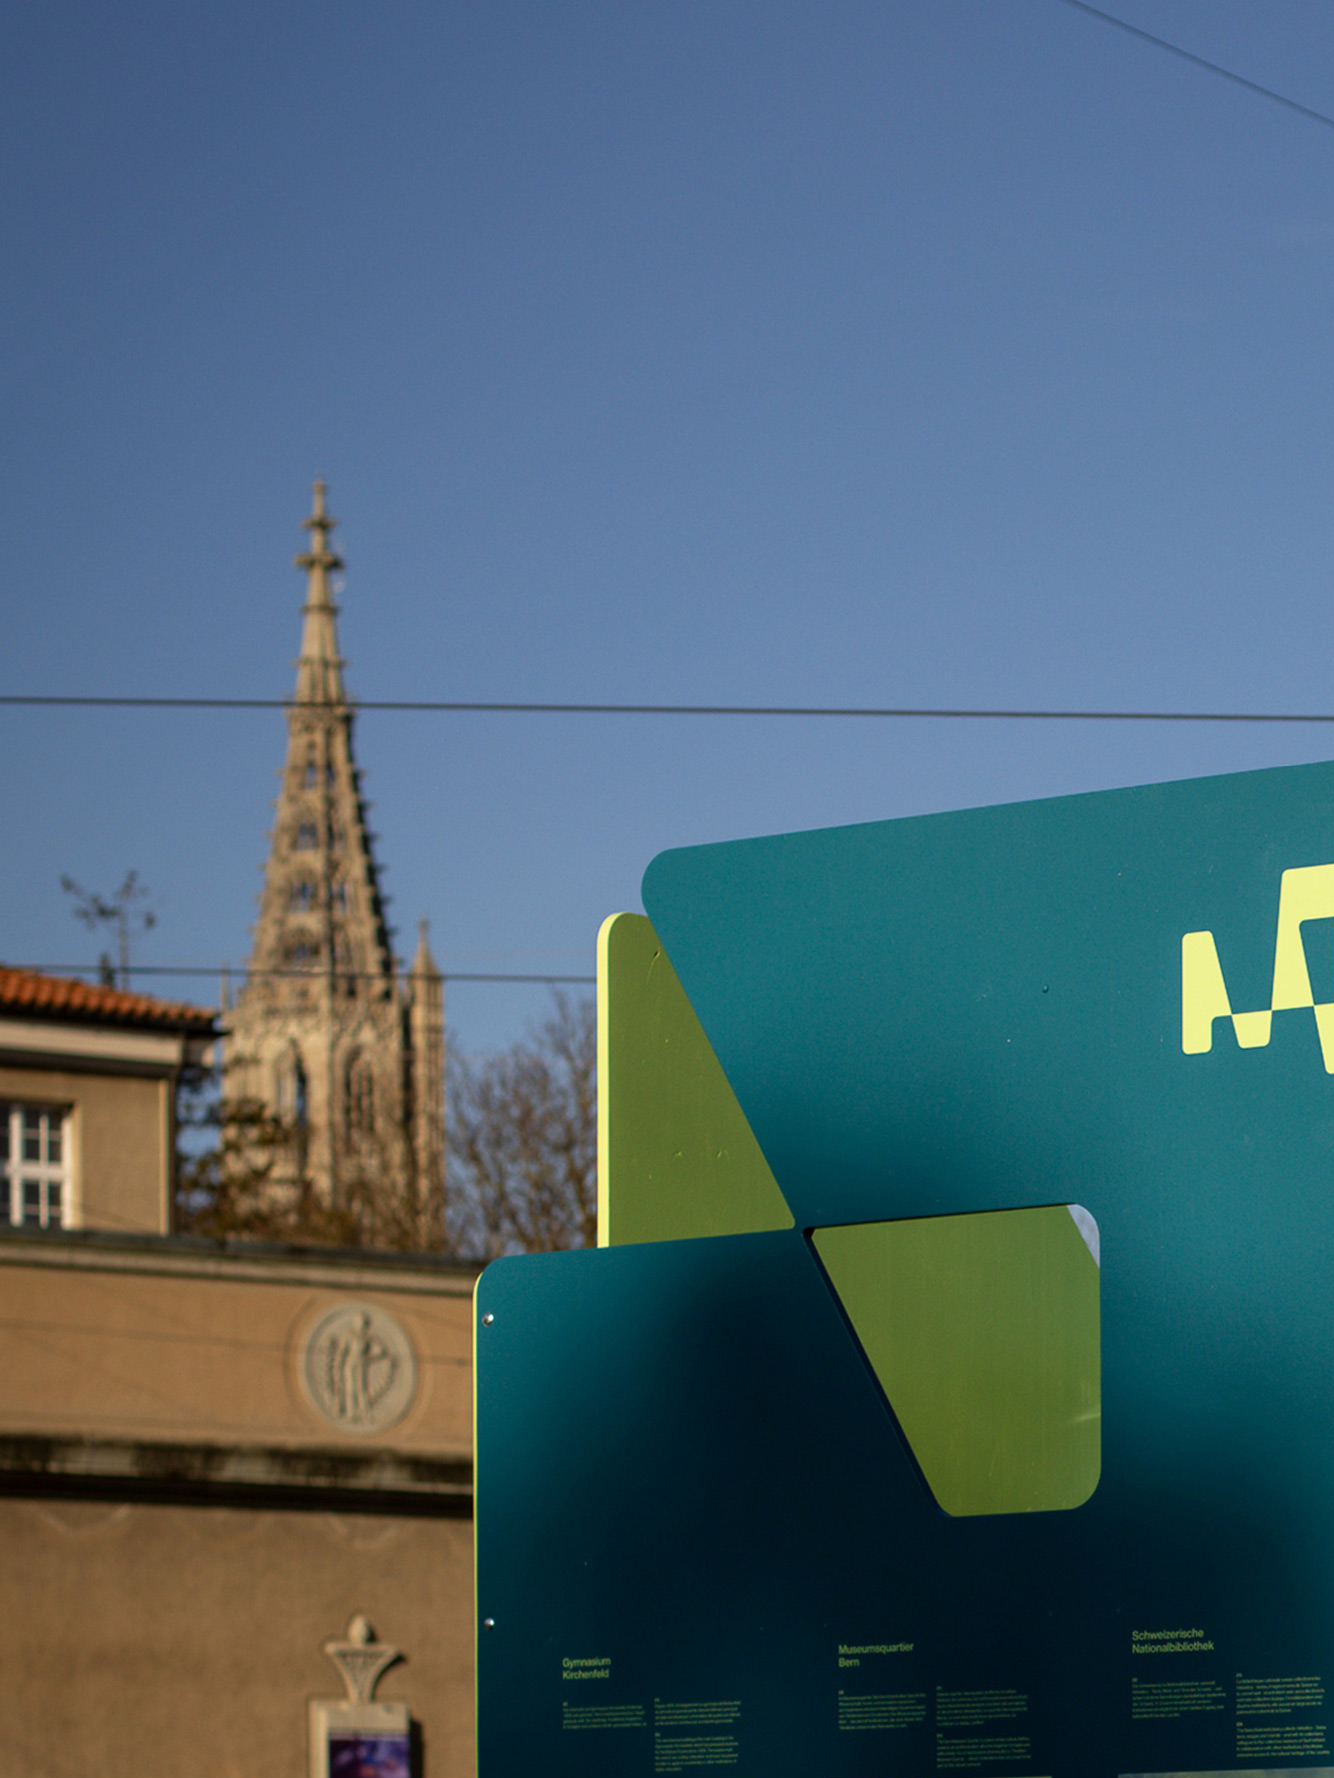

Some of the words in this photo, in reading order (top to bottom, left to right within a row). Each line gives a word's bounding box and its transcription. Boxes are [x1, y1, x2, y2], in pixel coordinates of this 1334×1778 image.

[1132, 1628, 1204, 1641] Schweizerische
[839, 1642, 914, 1655] Museumsquartier
[1132, 1640, 1214, 1654] Nationalbibliothek
[562, 1657, 611, 1669] Gymnasium
[839, 1657, 860, 1667] Bern
[562, 1669, 609, 1680] Kirchenfeld
